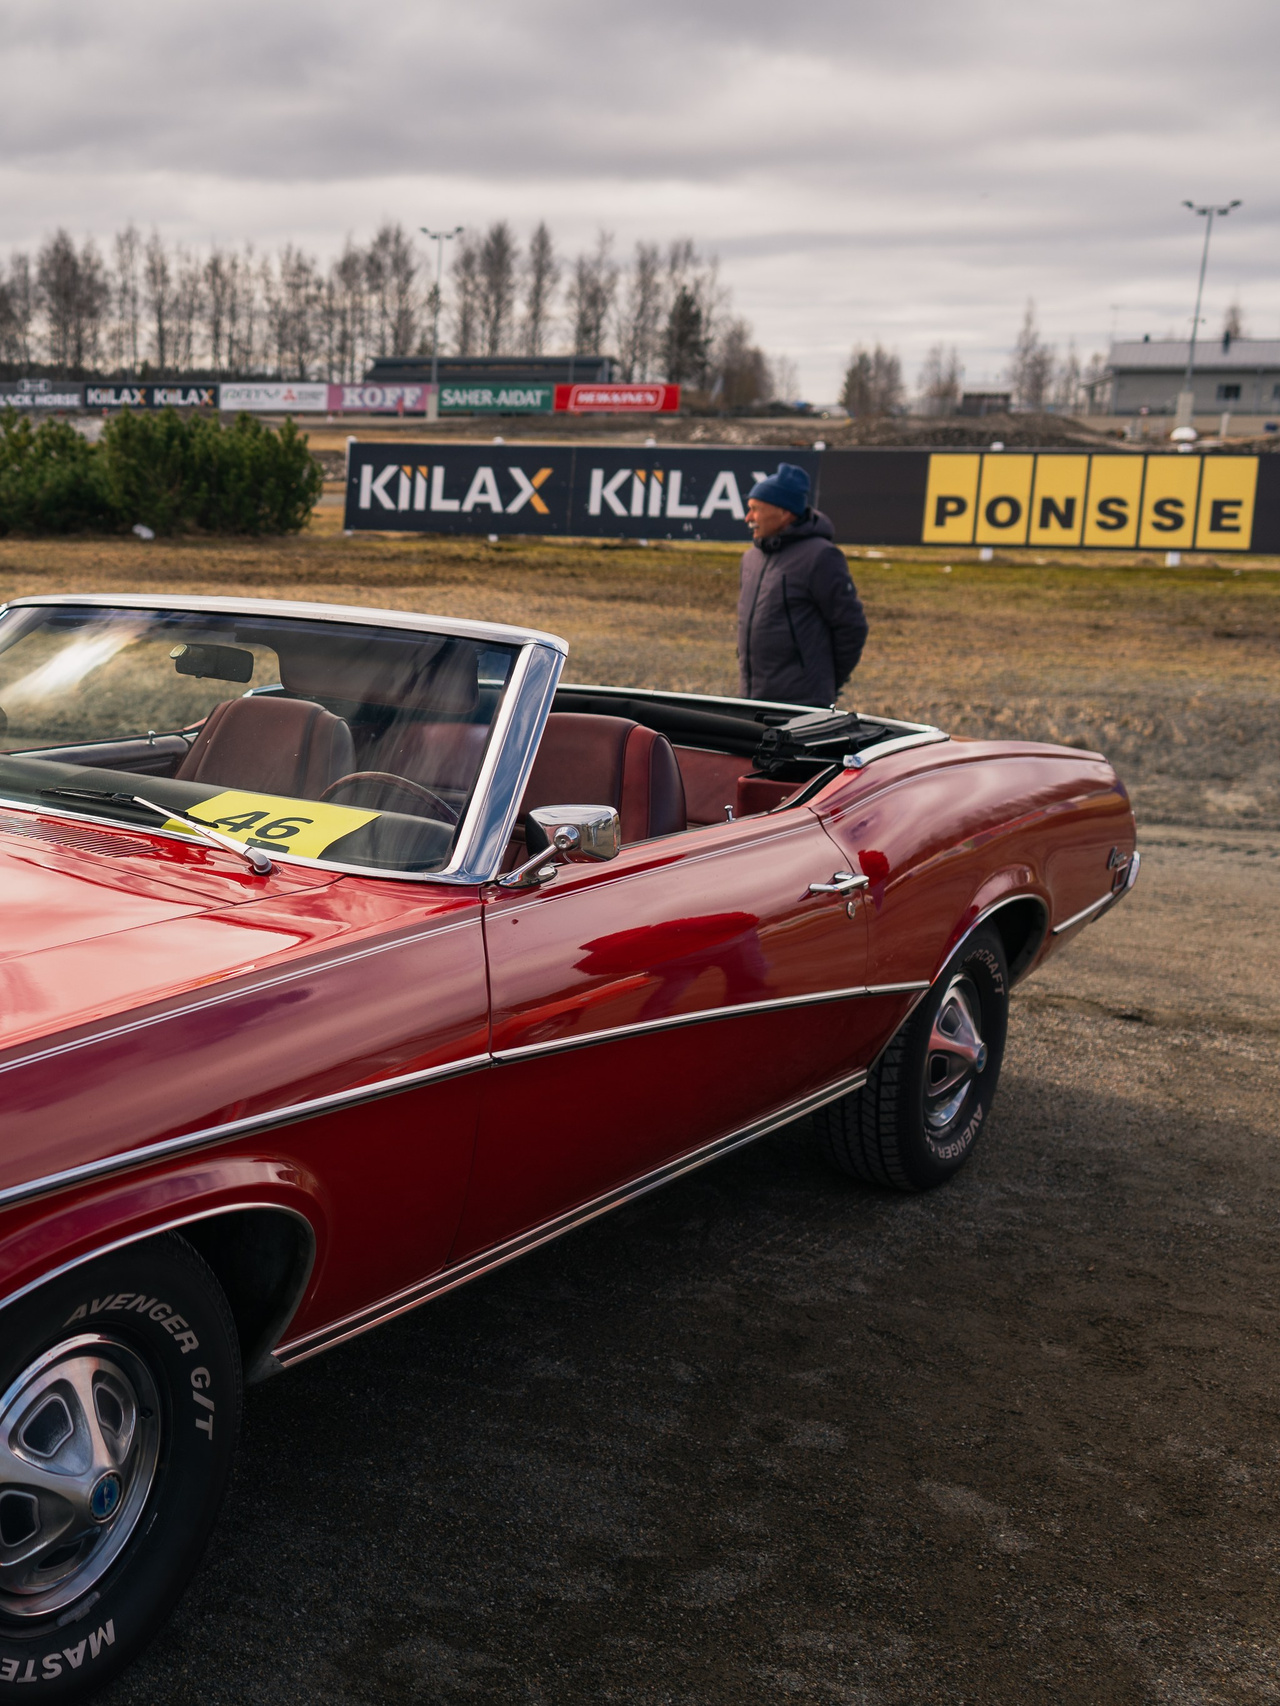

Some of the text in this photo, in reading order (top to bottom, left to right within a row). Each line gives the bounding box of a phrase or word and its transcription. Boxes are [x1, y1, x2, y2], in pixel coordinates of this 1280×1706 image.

[34, 393, 81, 406] HORSE
[341, 386, 422, 408] KOFF
[441, 388, 543, 407] SAHER-AIDAT
[933, 494, 1244, 534] PONSSE
[214, 810, 314, 840] 46
[937, 1103, 983, 1159] AVENGER
[62, 1293, 216, 1440] AVENGER G/T
